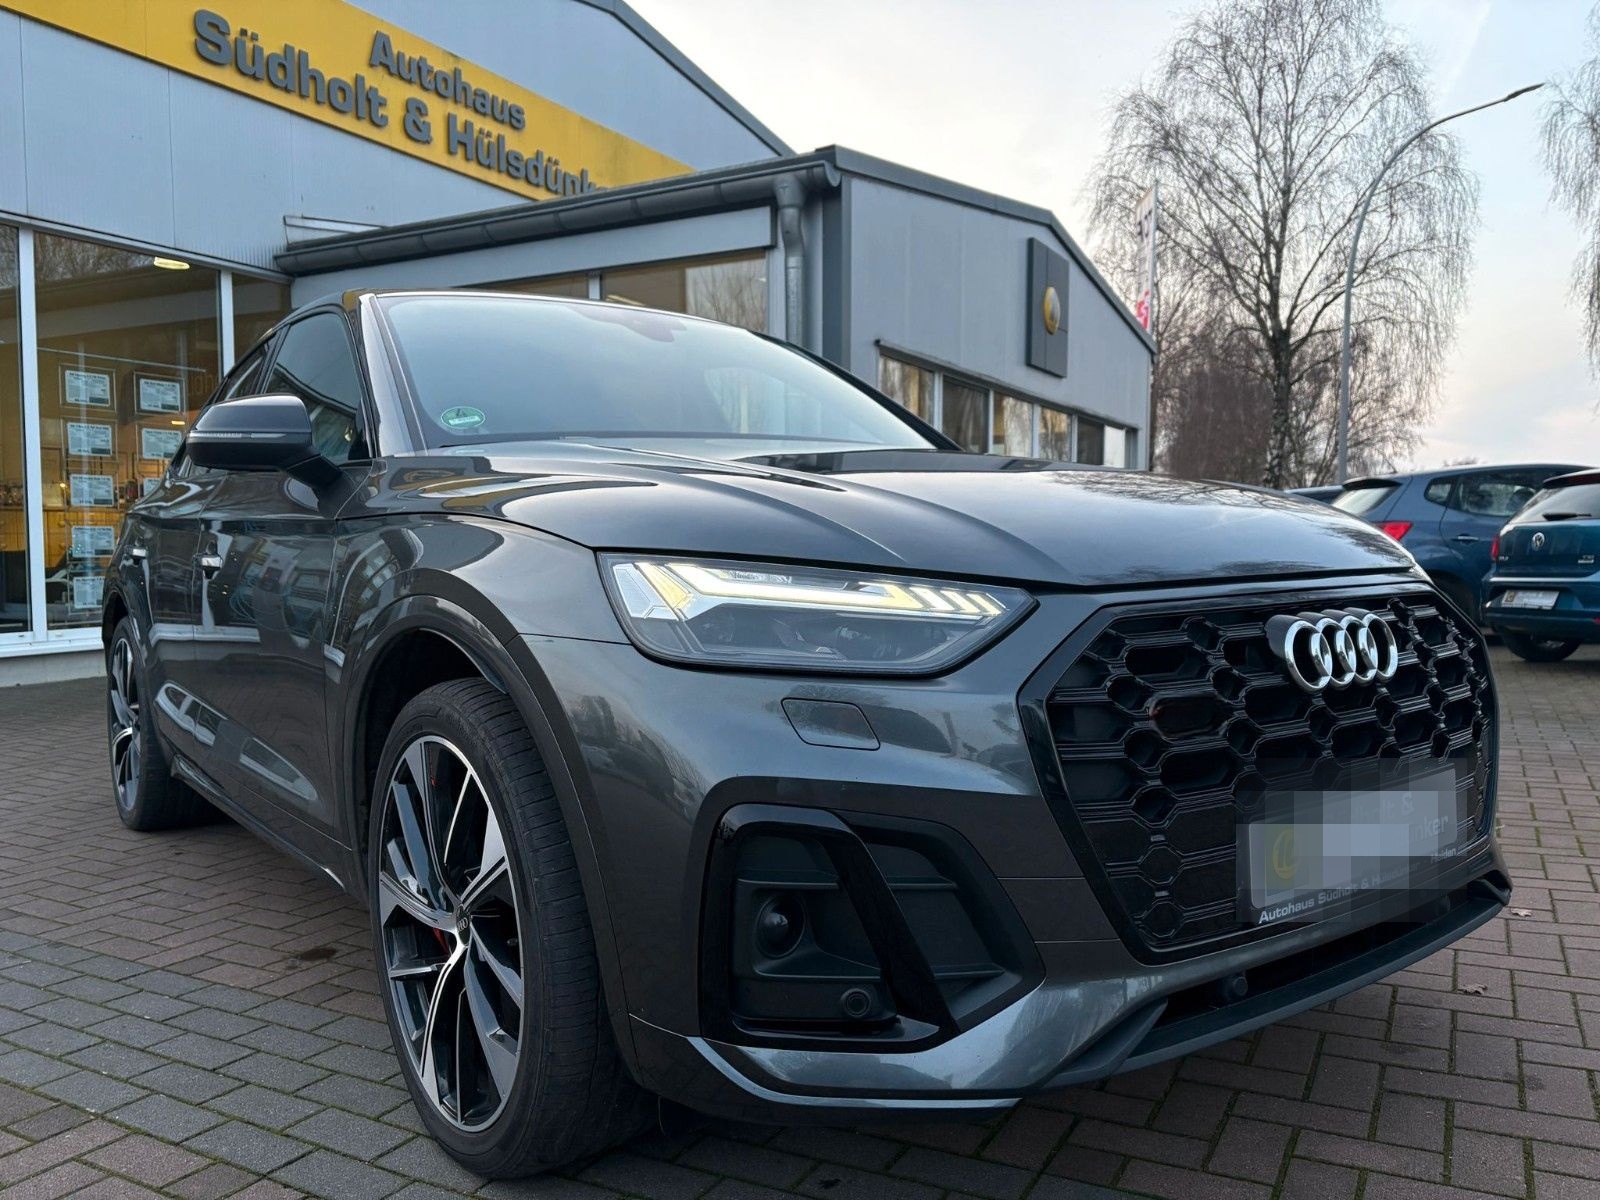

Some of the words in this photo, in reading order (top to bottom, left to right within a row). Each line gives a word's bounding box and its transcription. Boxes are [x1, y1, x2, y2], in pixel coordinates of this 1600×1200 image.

[194, 9, 389, 129] Südholt
[404, 97, 433, 145] &
[447, 112, 600, 197] Hülsdünk
[369, 30, 526, 130] Autohaus
[1258, 899, 1315, 924] Autohaus
[1318, 883, 1358, 904] Südholt
[1361, 877, 1370, 889] &
